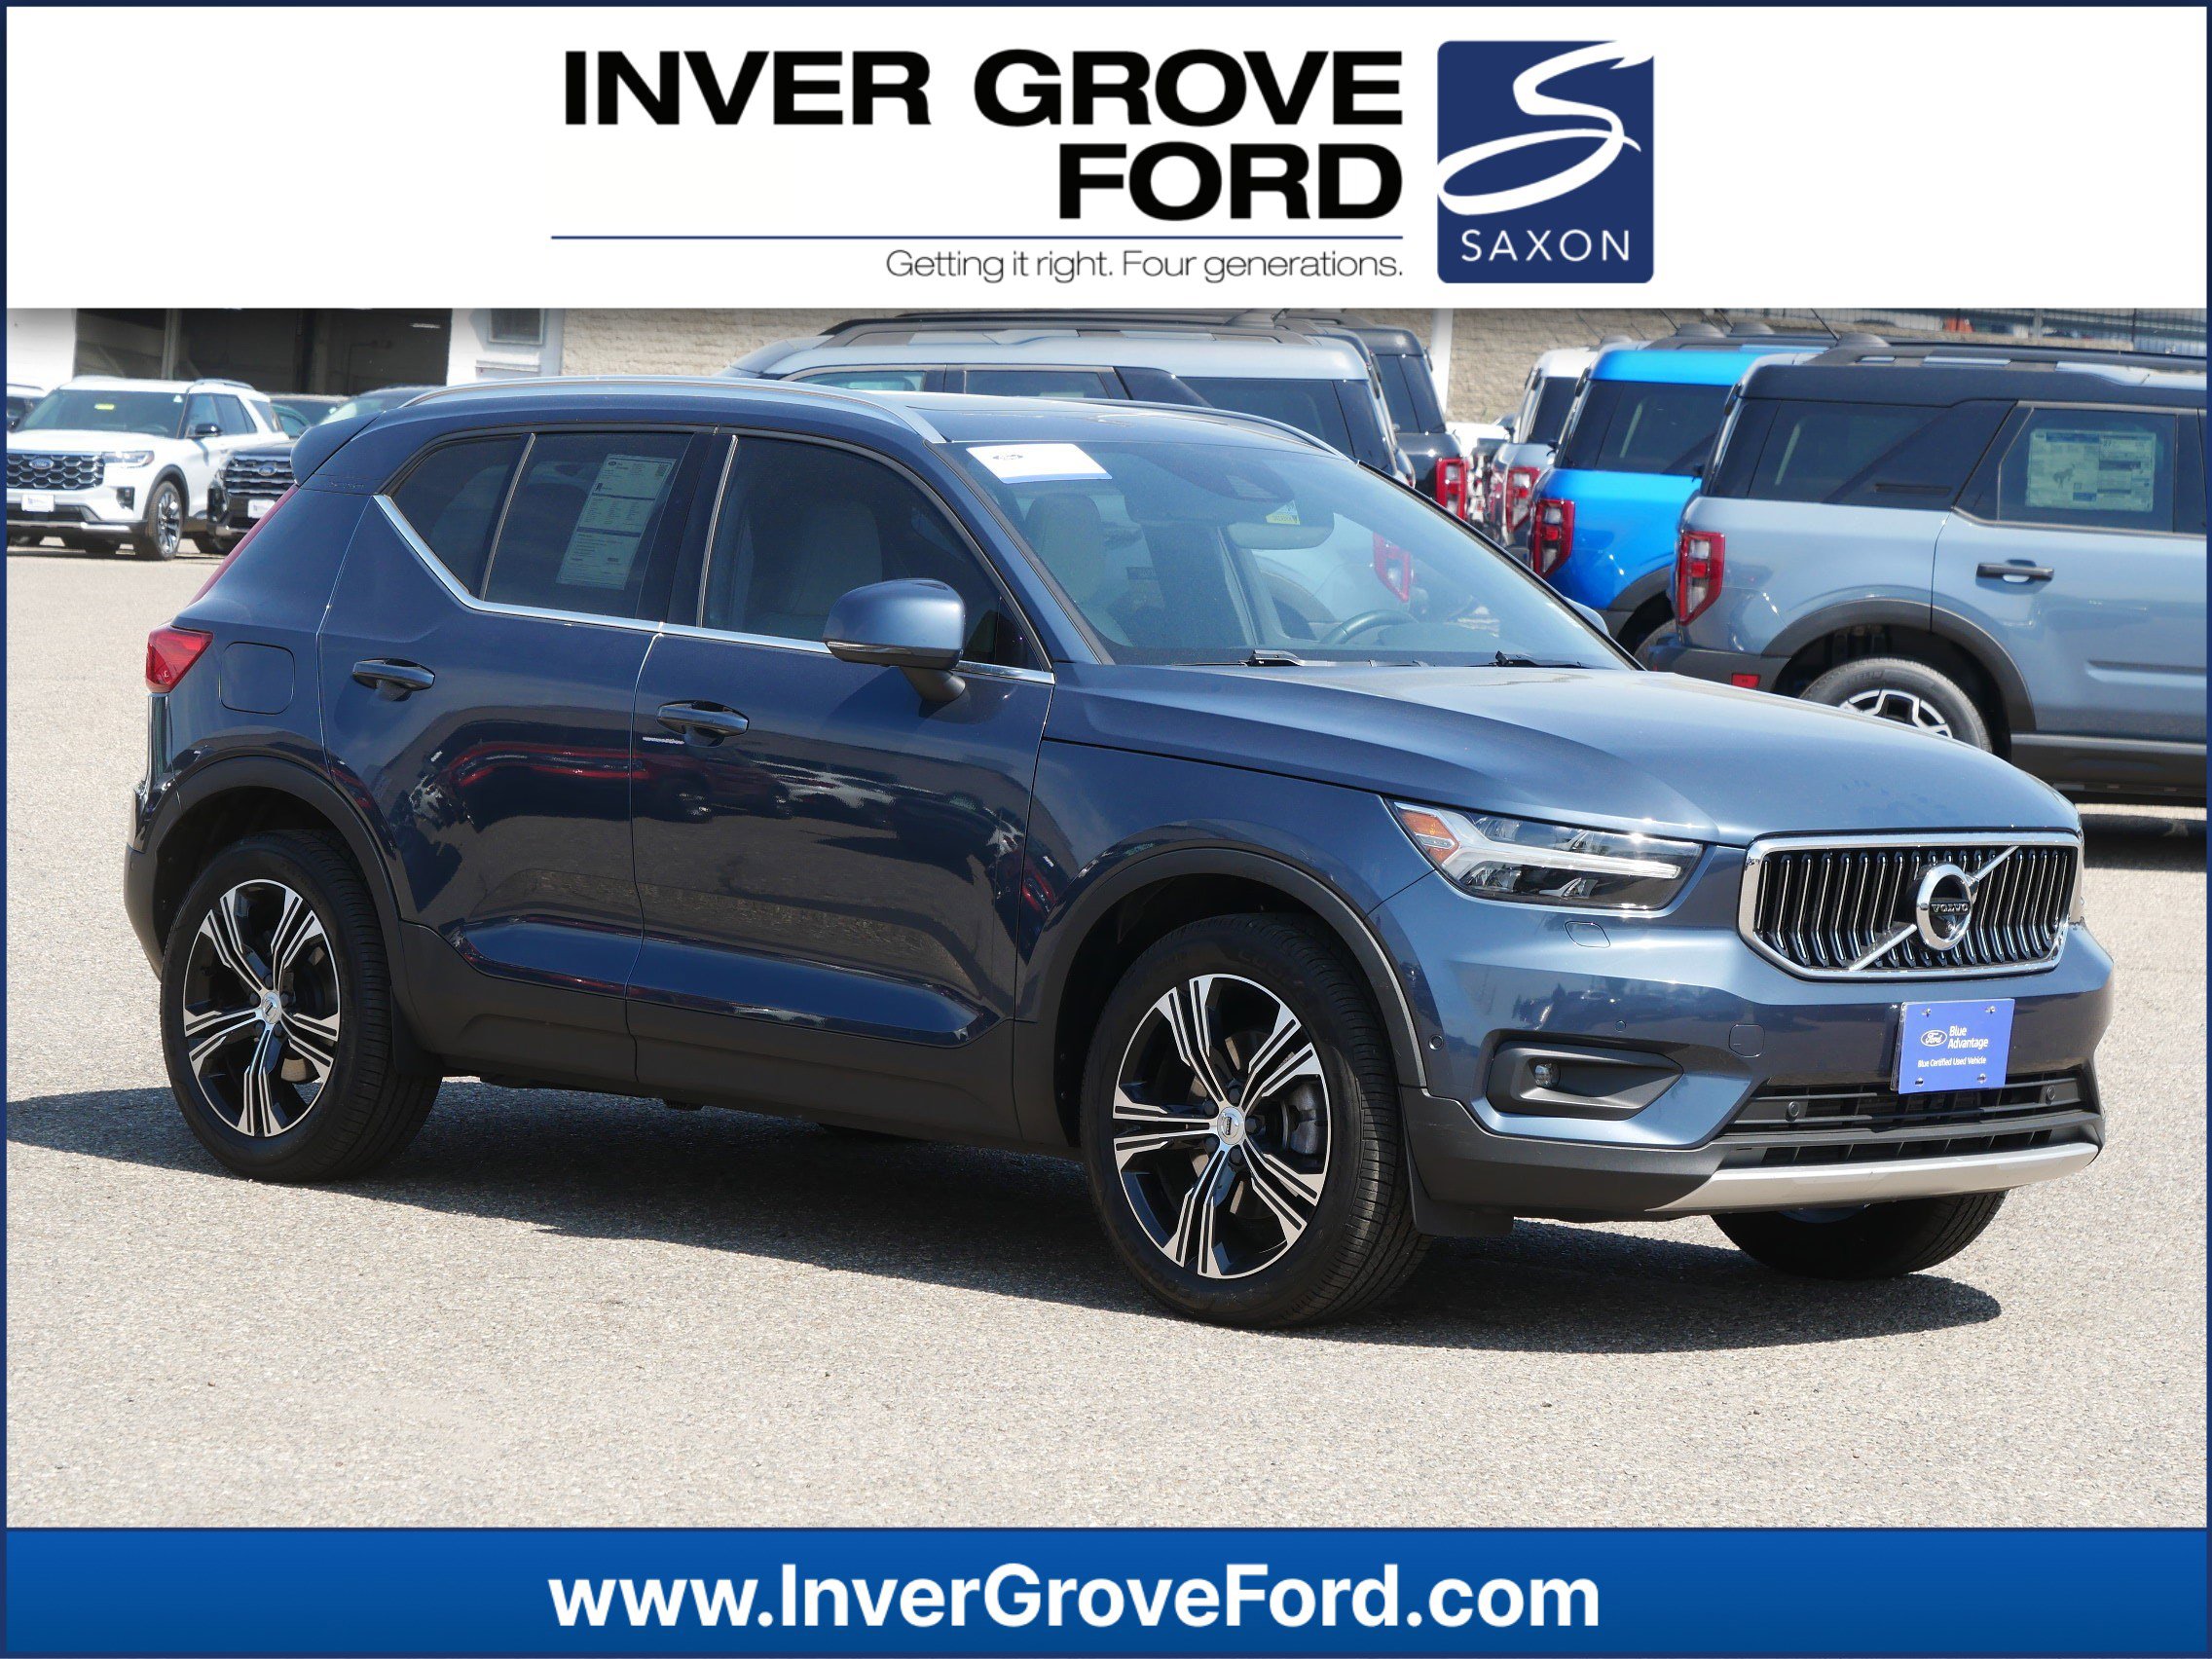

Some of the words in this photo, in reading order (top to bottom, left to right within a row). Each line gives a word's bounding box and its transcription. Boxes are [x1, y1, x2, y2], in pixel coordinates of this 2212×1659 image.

[1931, 902, 1969, 913] VOLVO
[1949, 1025, 1968, 1037] Blue
[1925, 1032, 1943, 1045] Ford
[1947, 1037, 1989, 1051] Advantage
[1917, 1059, 1930, 1068] Blue
[1930, 1057, 1952, 1067] Certified
[1953, 1056, 1968, 1066] Used
[1967, 1055, 1987, 1065] Vehicle
